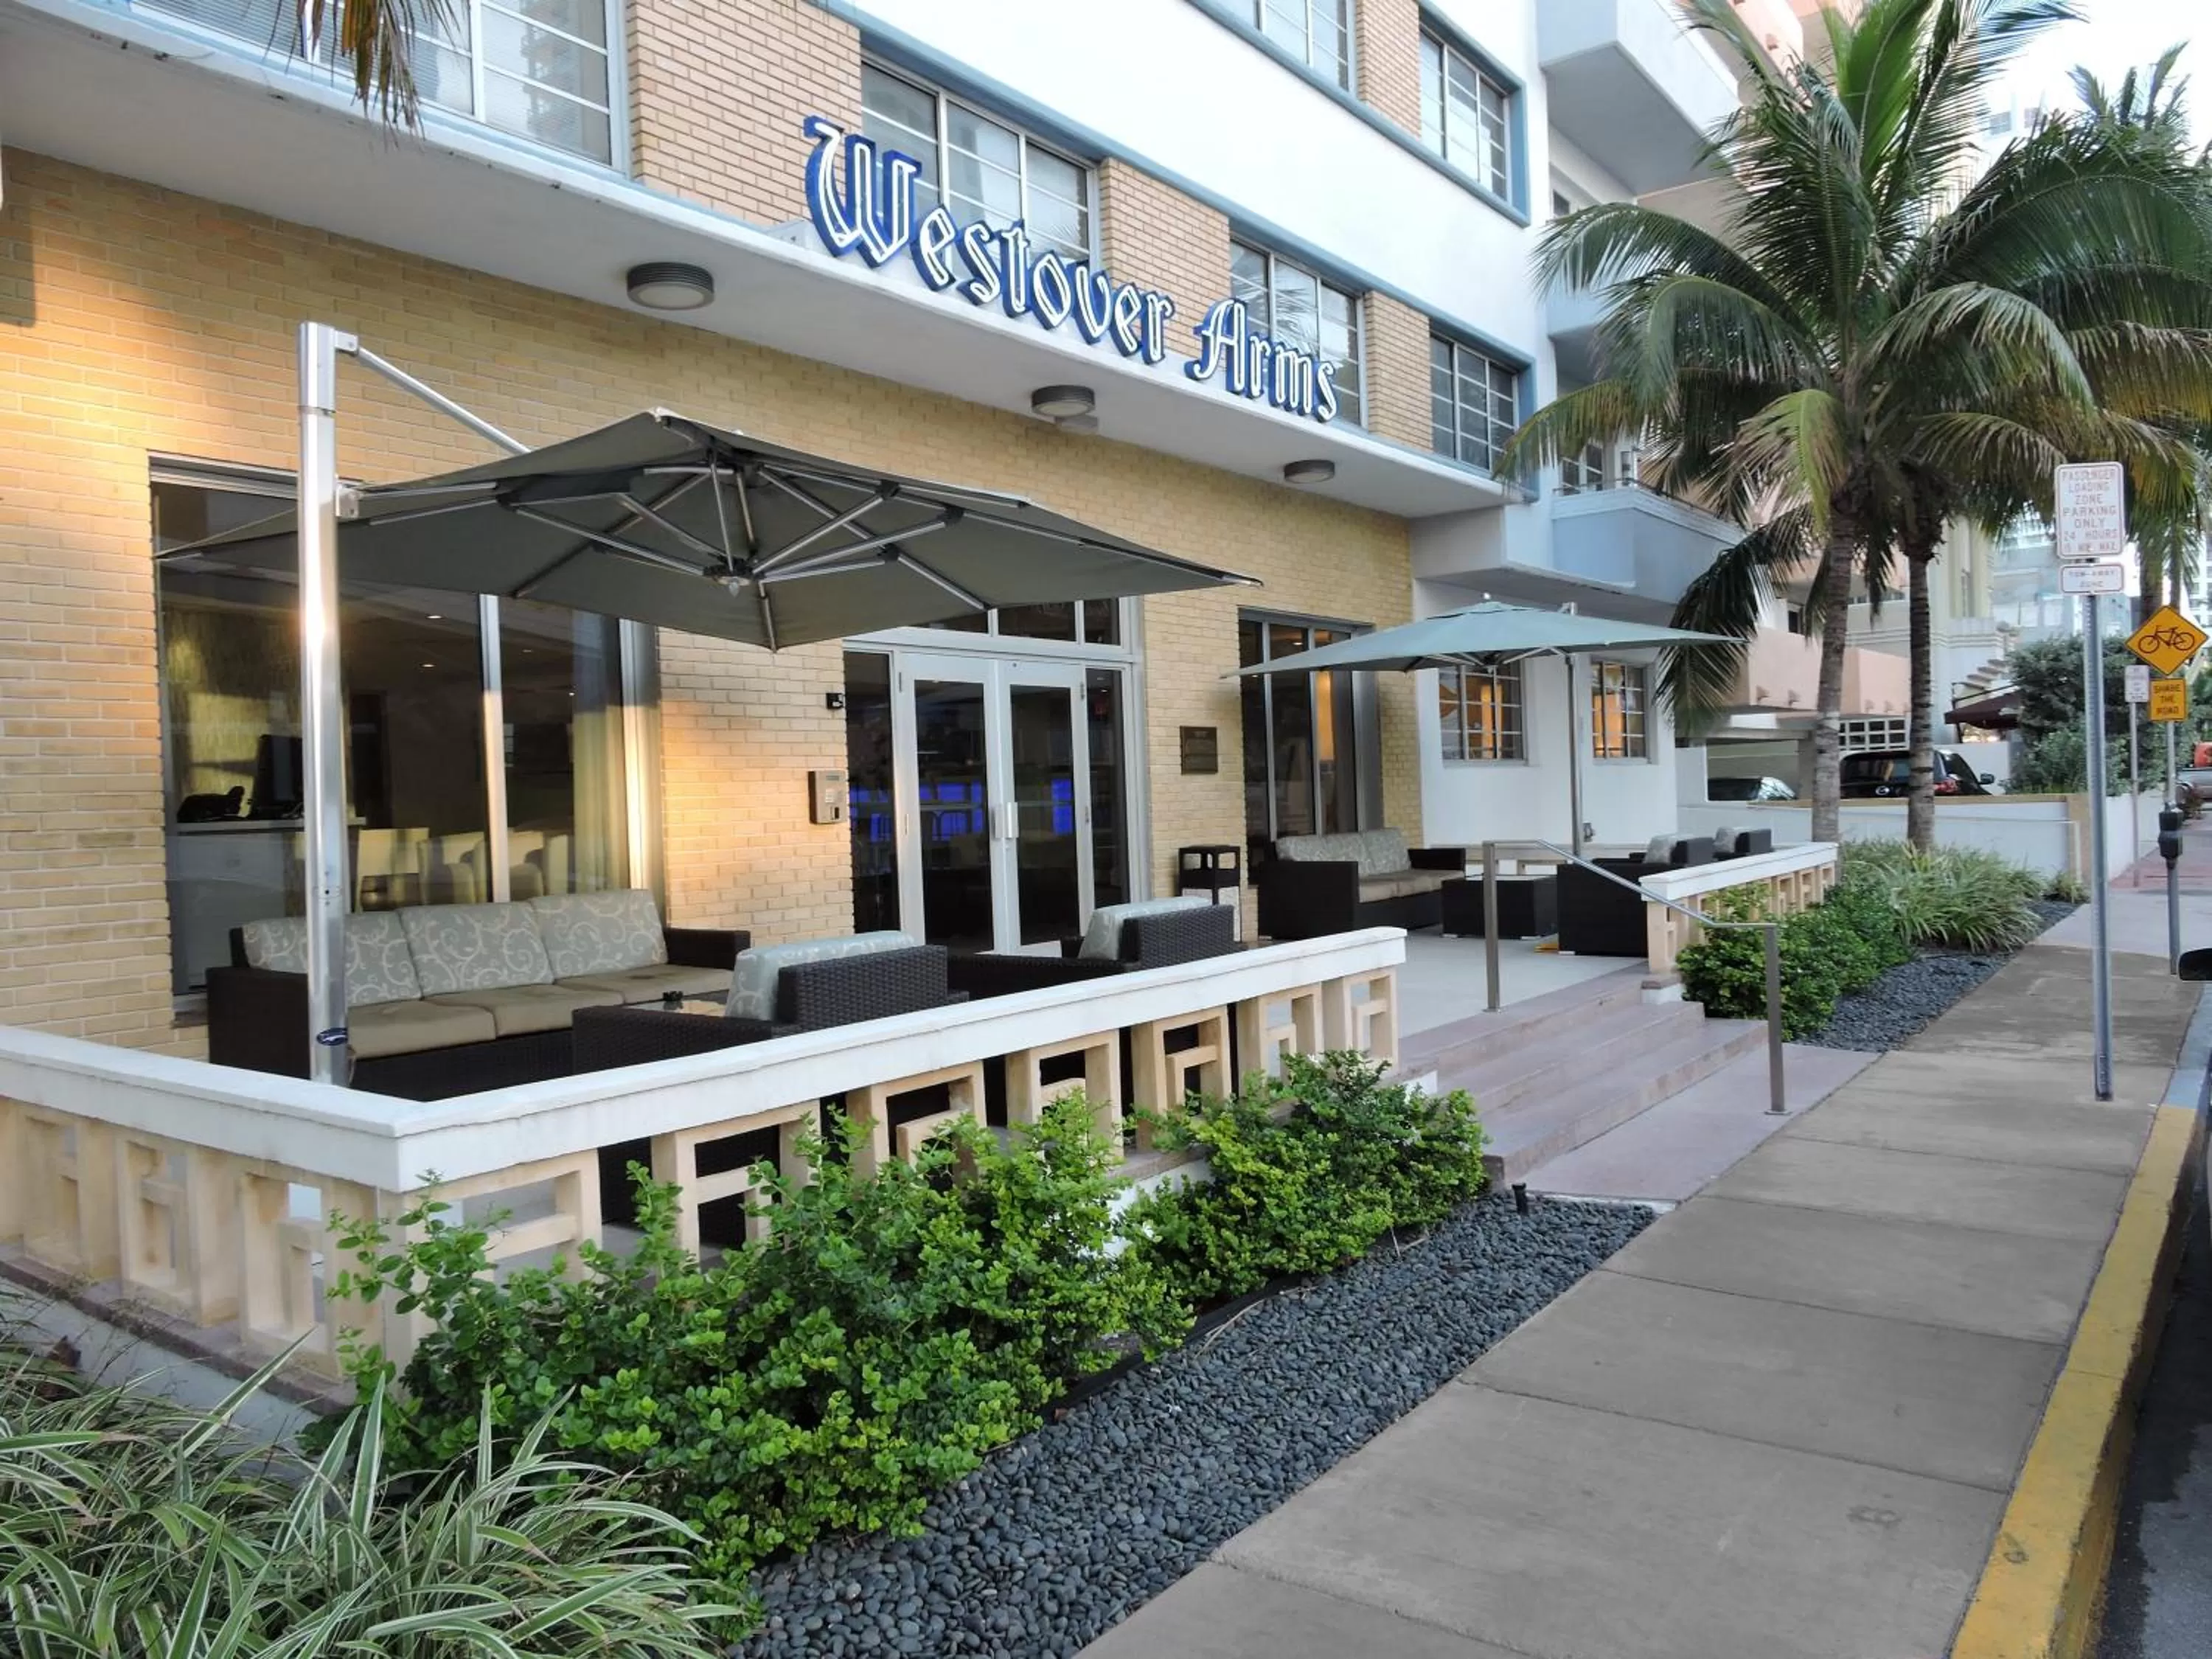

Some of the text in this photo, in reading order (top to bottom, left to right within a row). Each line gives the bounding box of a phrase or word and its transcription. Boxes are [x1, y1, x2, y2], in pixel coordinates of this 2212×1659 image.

[804, 115, 1339, 422] Westover Arms
[2068, 481, 2110, 493] LOADING
[2075, 493, 2104, 505] ZONE
[2062, 505, 2117, 517] PARKING
[2074, 518, 2106, 529] ONLY
[2084, 528, 2118, 540] HOURS
[2154, 684, 2182, 694] SHARE
[2159, 695, 2174, 704] THE
[2156, 706, 2180, 715] ROAD
